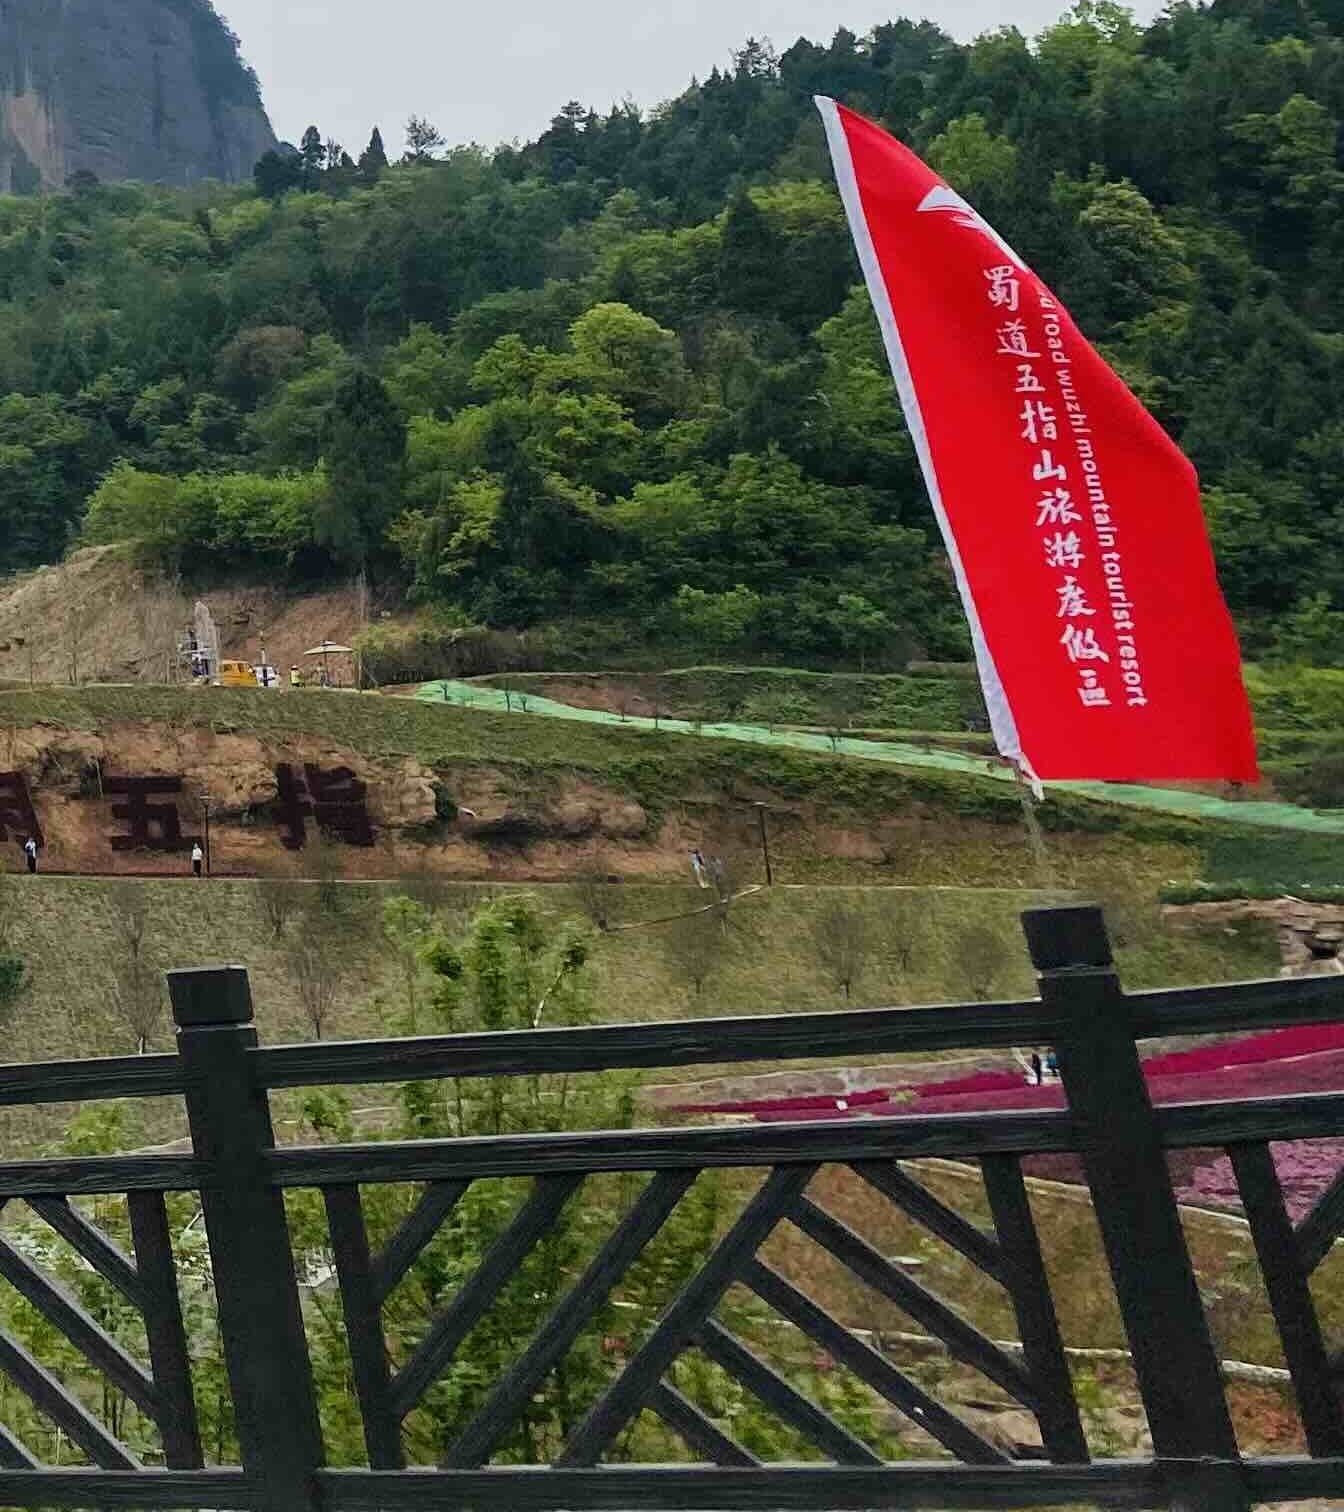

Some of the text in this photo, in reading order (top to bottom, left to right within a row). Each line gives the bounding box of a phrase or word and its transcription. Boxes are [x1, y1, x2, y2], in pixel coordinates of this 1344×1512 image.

[1042, 313, 1073, 364] road
[1055, 369, 1092, 434] wuzhi
[1074, 439, 1118, 547] mountain
[1101, 551, 1136, 630] tourist
[1116, 635, 1149, 707] resort
